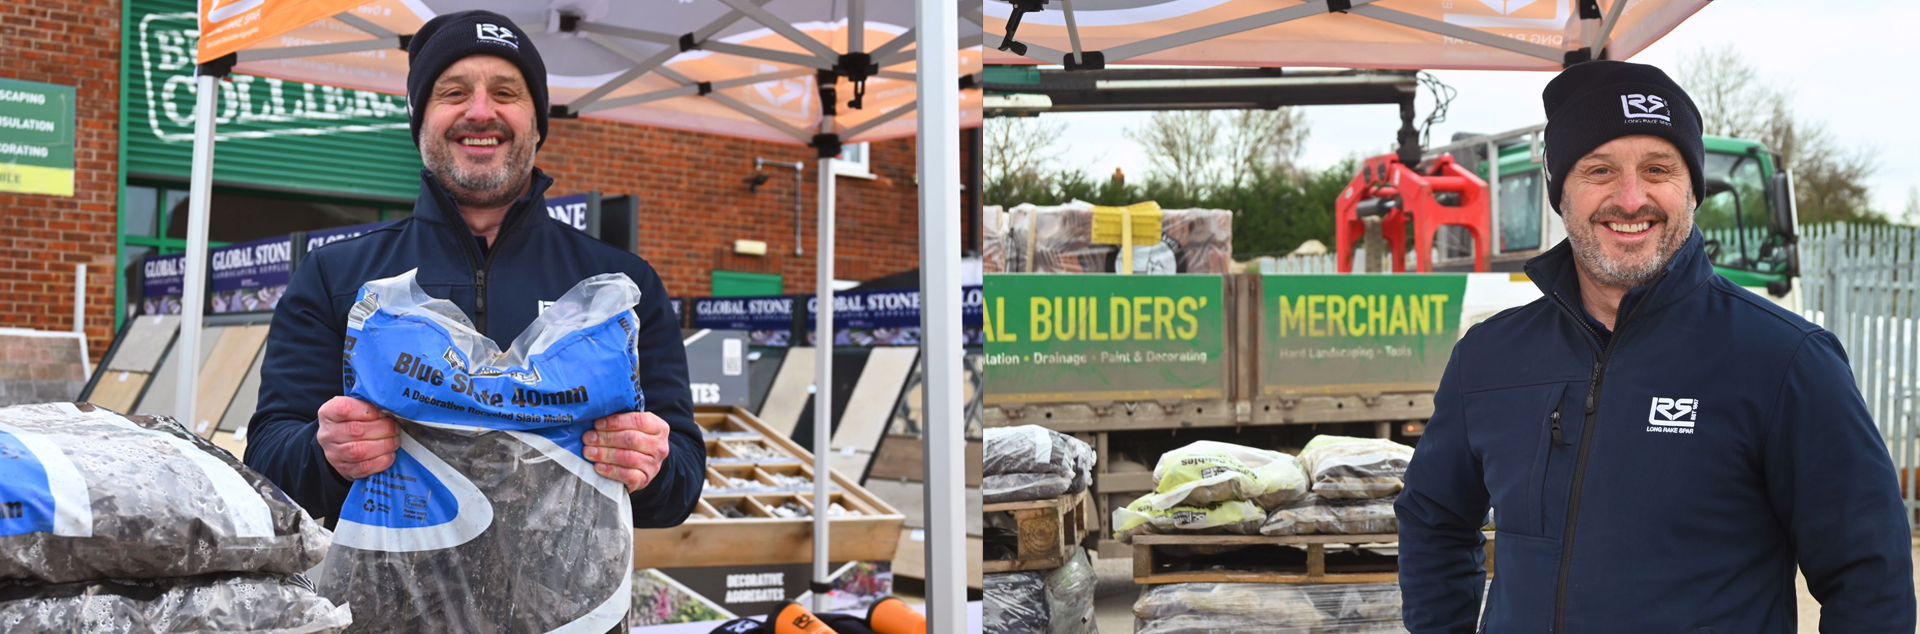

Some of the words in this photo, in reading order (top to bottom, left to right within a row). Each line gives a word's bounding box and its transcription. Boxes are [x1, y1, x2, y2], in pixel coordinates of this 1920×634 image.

[145, 259, 178, 278] GLOBAL
[212, 247, 254, 271] GLOBAL
[696, 300, 747, 315] GLOBAL
[748, 298, 793, 314] STONE
[807, 295, 865, 313] GBAL
[867, 292, 920, 310] STONE
[1279, 294, 1449, 337] MERCHANT
[1033, 353, 1087, 366] Drainage
[1101, 351, 1130, 364] Paint
[1134, 352, 1142, 363] &
[1146, 351, 1207, 364] Decorating
[1280, 348, 1306, 359] Hard
[1309, 347, 1374, 360] Landscaping
[1385, 345, 1412, 357] Tools
[393, 352, 445, 386] Blue
[511, 385, 589, 408] 40mm
[402, 387, 410, 397] A
[412, 390, 465, 412] Decorative
[468, 406, 513, 421] Recycled
[516, 413, 541, 423] Slate
[544, 414, 574, 423] Mulch
[727, 573, 784, 588] DECORATIVE
[725, 588, 784, 603] AGGREGATES
